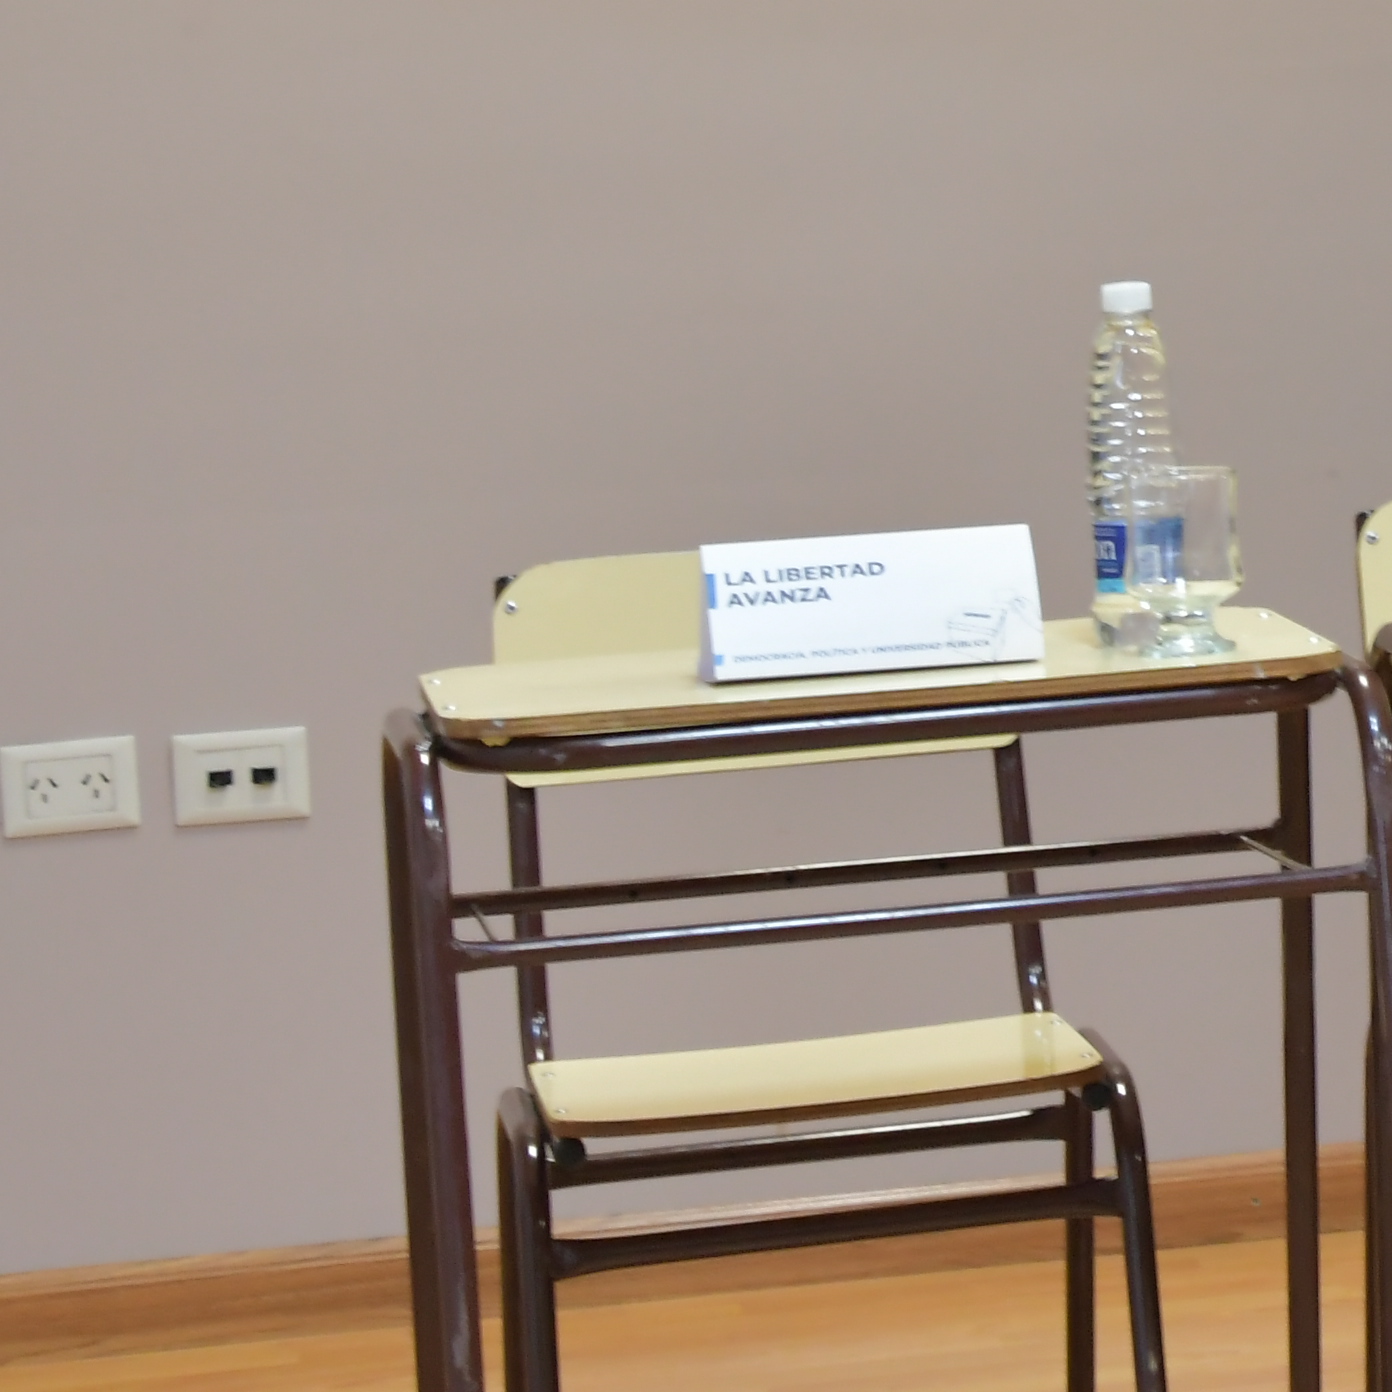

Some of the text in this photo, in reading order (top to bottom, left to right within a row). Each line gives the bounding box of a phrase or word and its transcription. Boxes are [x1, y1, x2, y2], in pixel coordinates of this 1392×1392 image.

[724, 561, 885, 586] LA LIBERTAD
[727, 586, 832, 608] AVANZA
